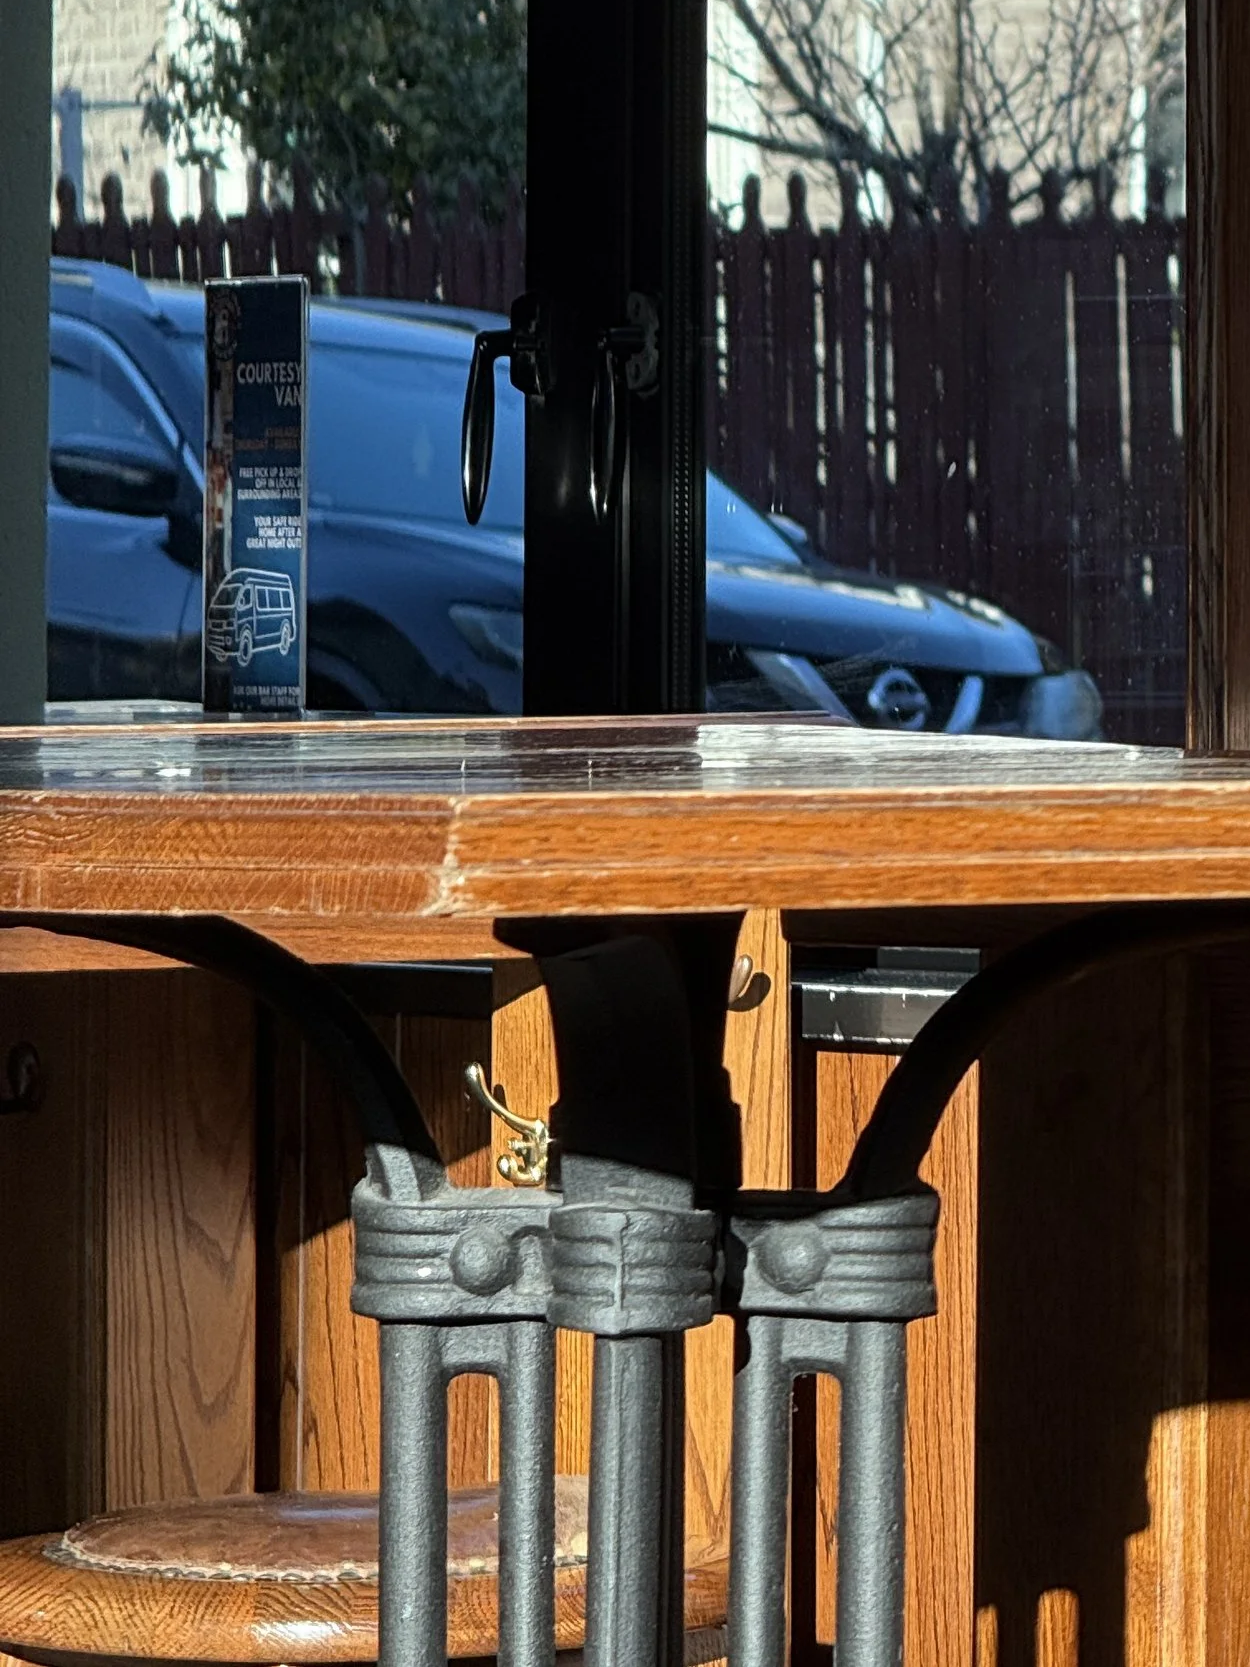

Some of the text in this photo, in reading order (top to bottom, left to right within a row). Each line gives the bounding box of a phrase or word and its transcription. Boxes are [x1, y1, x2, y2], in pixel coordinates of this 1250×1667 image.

[236, 361, 301, 385] COURTESY
[274, 384, 302, 407] VAN
[239, 466, 253, 478] FREE
[254, 466, 268, 478] PICK
[269, 466, 278, 478] UP
[255, 477, 267, 488] OFF
[268, 477, 275, 488] IN
[276, 477, 296, 488] LOCAL
[237, 489, 281, 500] SURROUNDING
[254, 515, 271, 527] YOUR
[272, 515, 287, 527] SAFE
[258, 526, 276, 537] HOME
[277, 526, 296, 537] AFTER
[246, 537, 266, 549] GREAT
[267, 537, 286, 548] NIGHT
